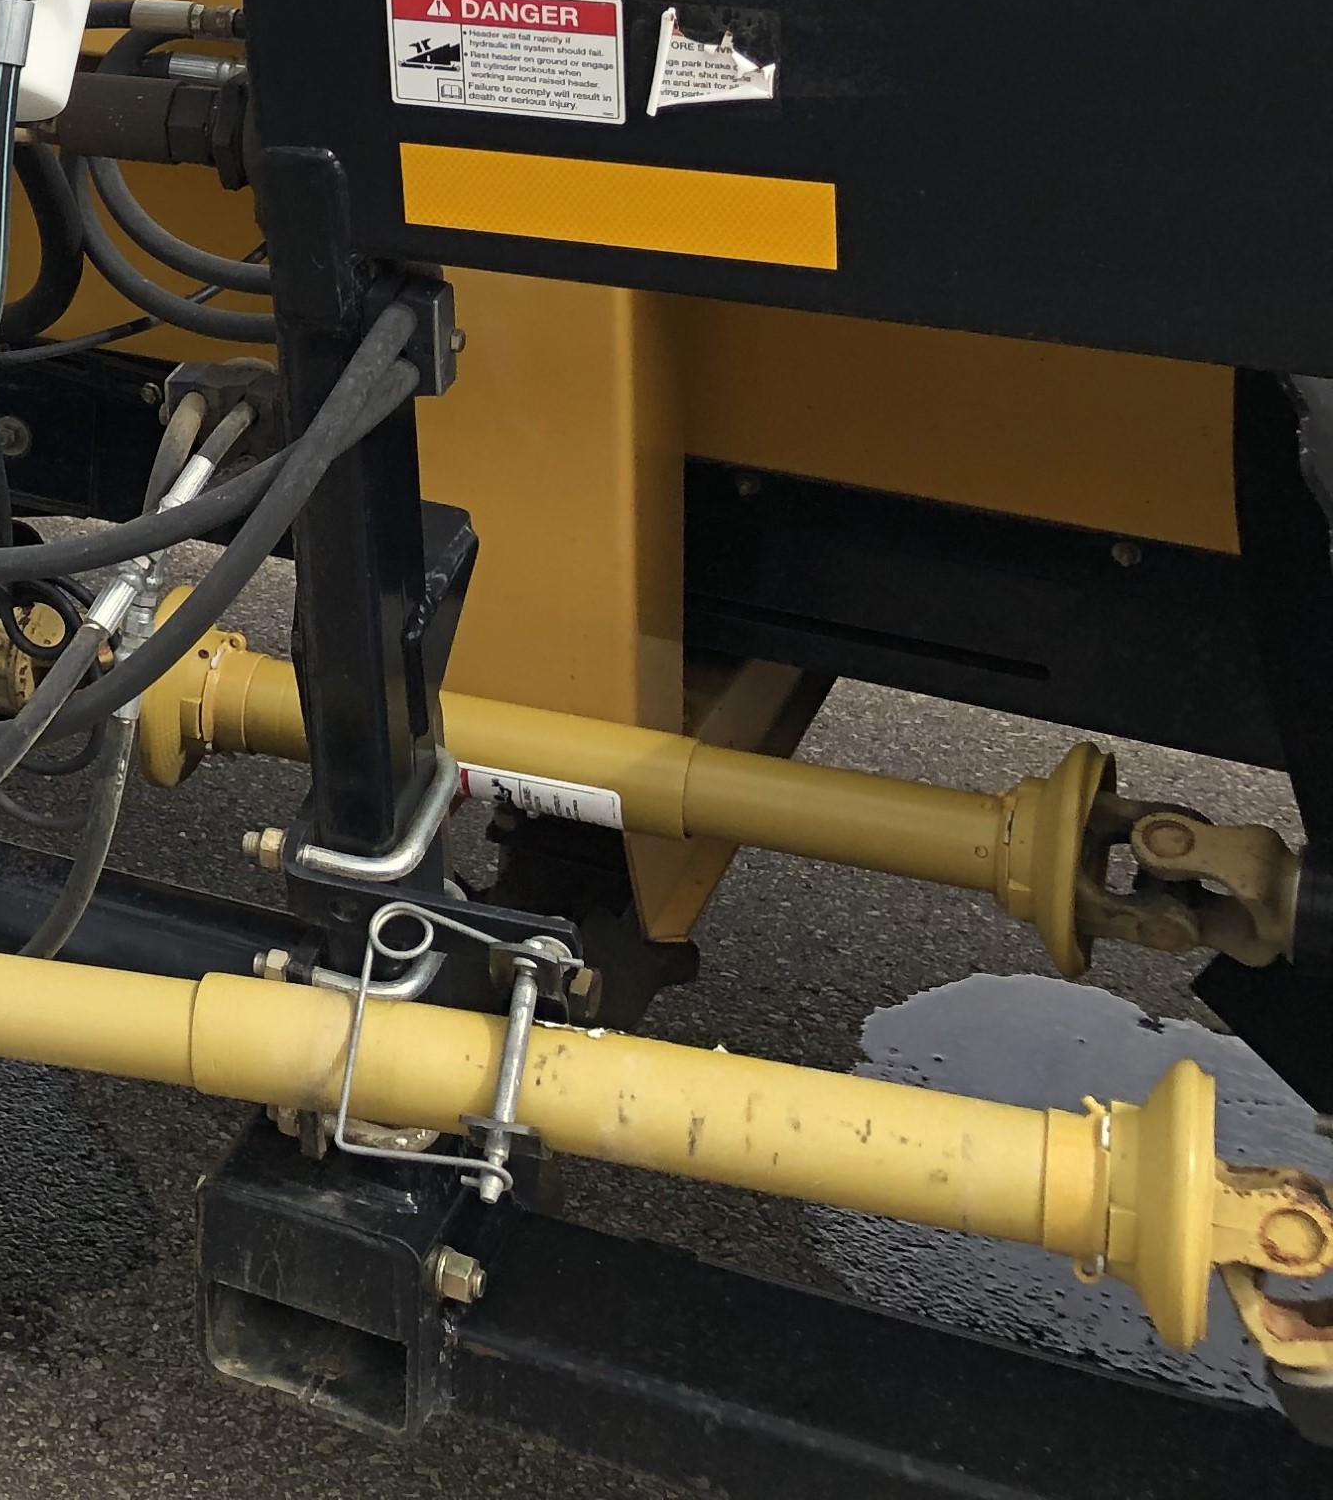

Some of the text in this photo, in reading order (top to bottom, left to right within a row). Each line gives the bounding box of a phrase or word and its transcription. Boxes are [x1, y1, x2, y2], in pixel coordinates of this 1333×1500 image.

[461, 0, 579, 27] DANGER
[469, 29, 570, 44] Header will fall rapidly if
[469, 40, 603, 56] hydraulic lift system should fail.
[470, 50, 489, 59] Rest
[491, 52, 522, 62] header
[536, 56, 568, 68] ground
[582, 60, 614, 71] engage
[470, 60, 581, 77] lift cylinder lockouts when
[681, 60, 702, 69] park
[704, 61, 731, 71] brake
[471, 70, 599, 88] working around raised header.
[676, 70, 696, 78] unit,
[698, 72, 718, 80] shut
[468, 82, 611, 102] Failure to comply will result in
[673, 79, 691, 88] and
[693, 81, 712, 89] wait
[714, 81, 727, 90] for
[468, 92, 495, 102] death
[511, 95, 546, 106] serious
[549, 99, 577, 110] injury.
